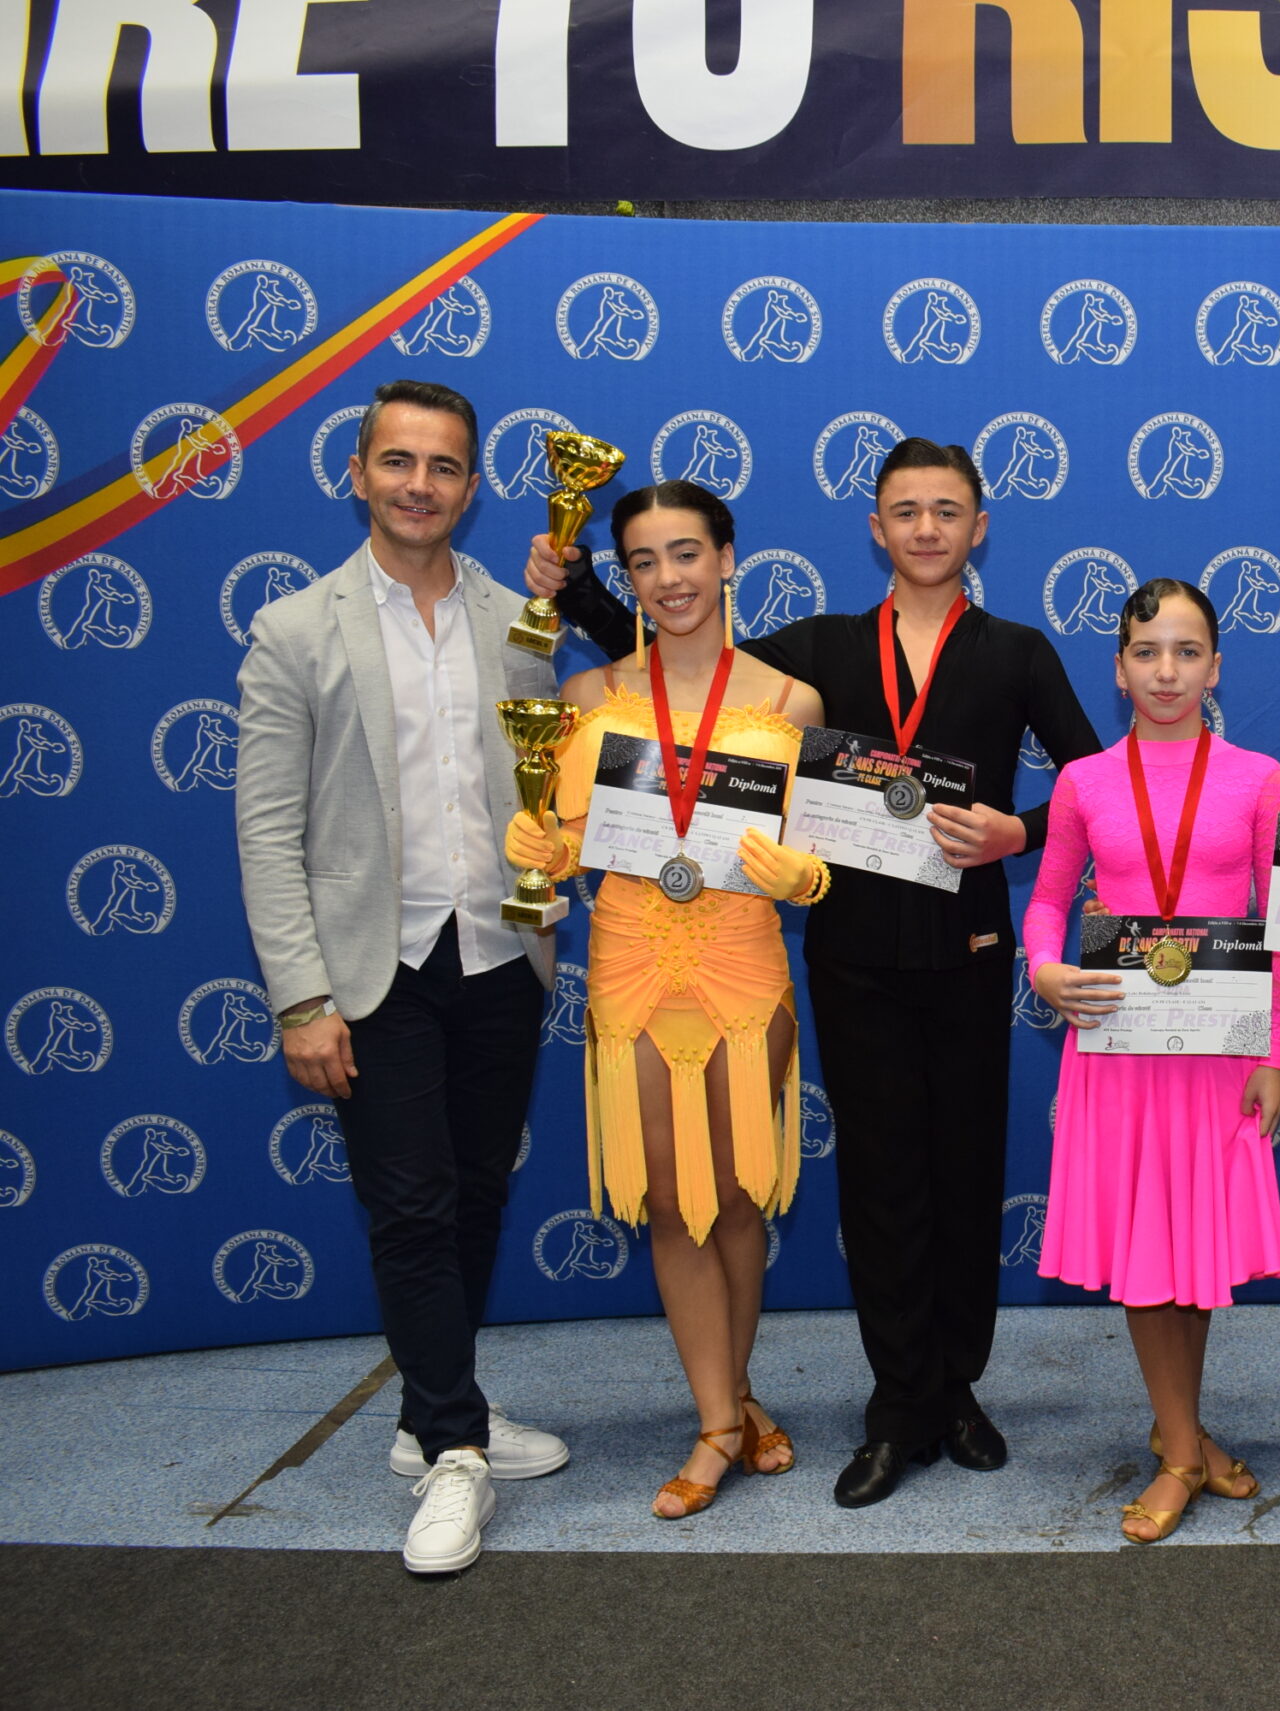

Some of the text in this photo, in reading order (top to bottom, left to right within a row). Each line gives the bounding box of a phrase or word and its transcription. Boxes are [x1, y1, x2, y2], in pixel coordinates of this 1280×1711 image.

[270, 263, 284, 273] DE
[285, 270, 309, 294] DANS
[299, 297, 314, 334] SPORTI
[615, 275, 629, 285] DE
[630, 282, 652, 305] DANS
[939, 280, 952, 290] DE
[953, 287, 974, 310] DANS
[1251, 284, 1263, 293] DE
[709, 413, 722, 423] DE
[723, 419, 745, 443] DANS
[101, 556, 116, 566] DE
[118, 562, 143, 588] DANS
[728, 776, 778, 794] Diplomă
[922, 772, 966, 792] Diplomă
[895, 790, 906, 806] 2
[671, 872, 683, 887] 2
[1212, 939, 1262, 953] Diplomă
